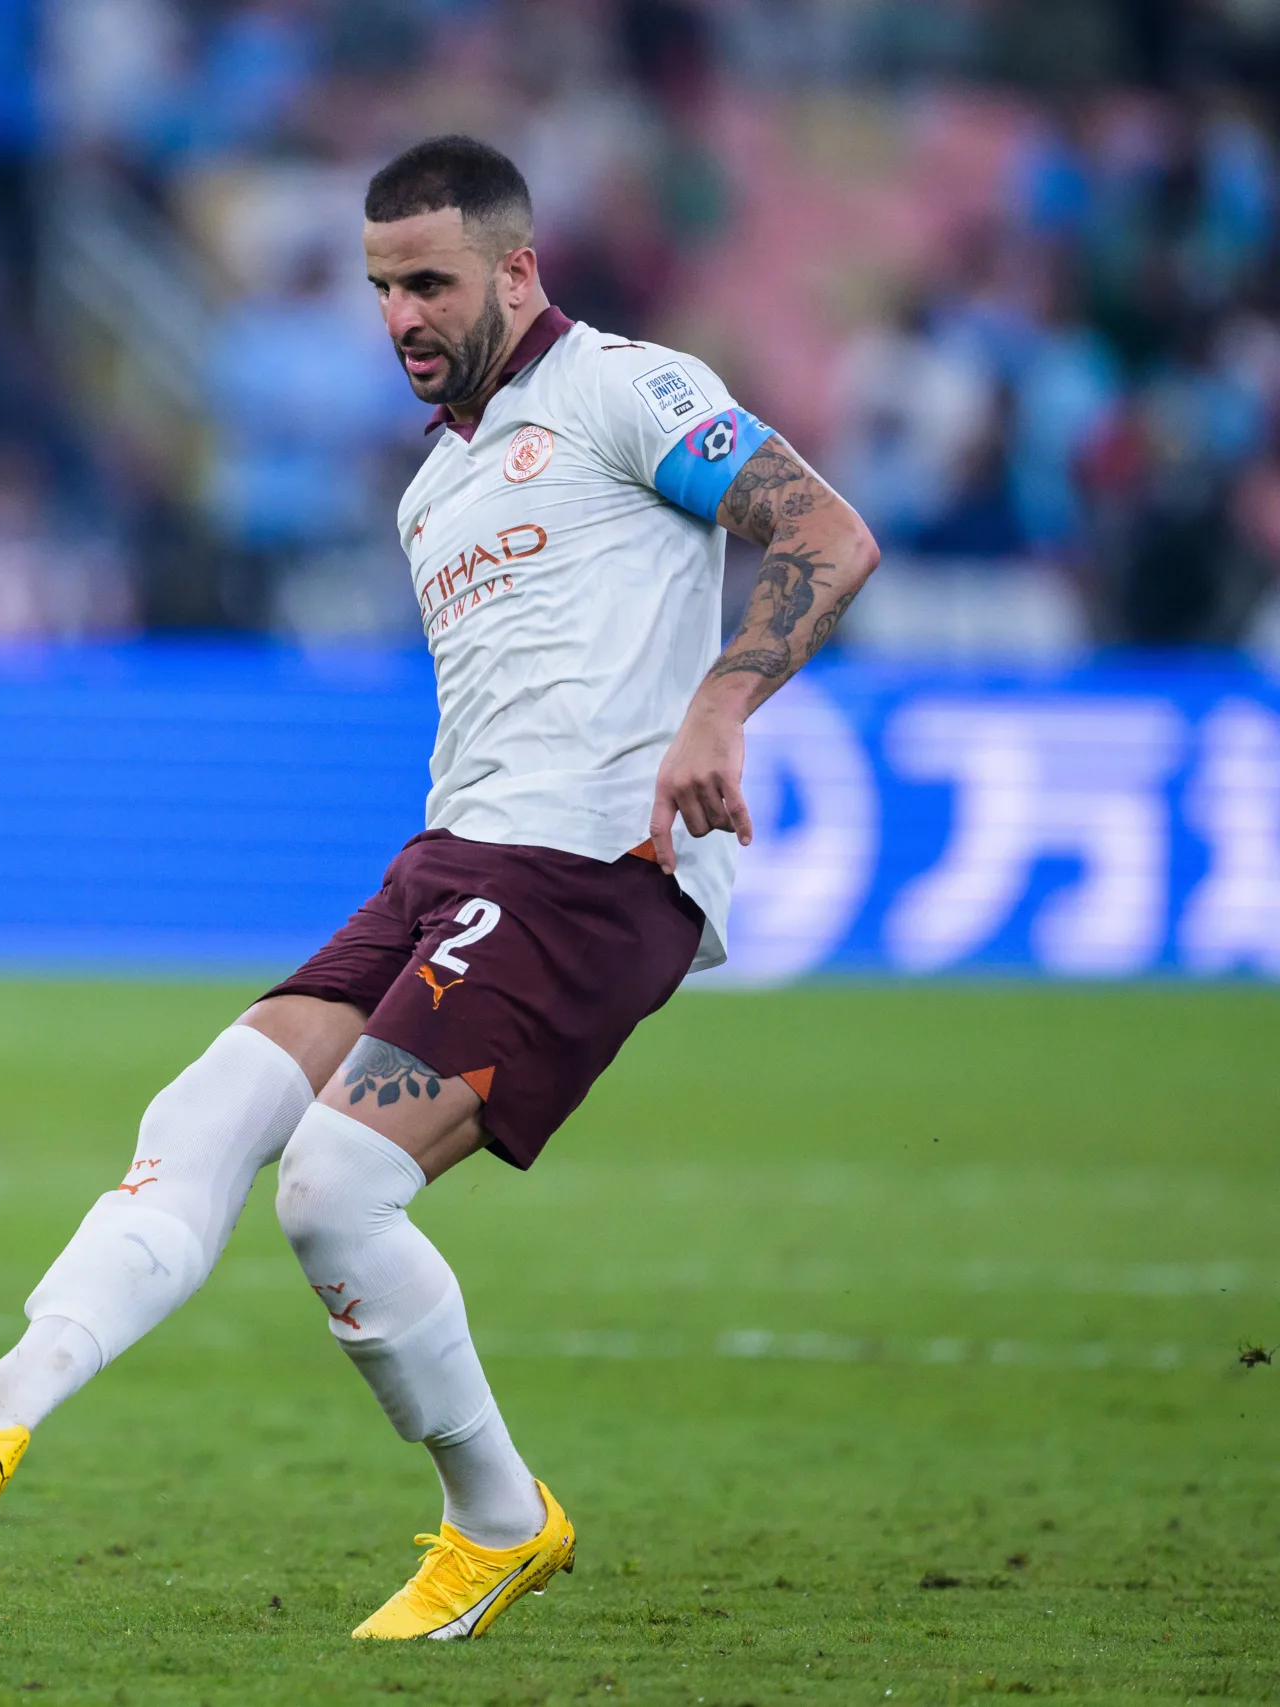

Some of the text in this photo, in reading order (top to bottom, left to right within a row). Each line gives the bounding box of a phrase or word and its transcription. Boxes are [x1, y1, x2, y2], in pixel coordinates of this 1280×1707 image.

[646, 371, 679, 389] FOOTBALL
[652, 378, 686, 400] UNITES
[658, 386, 694, 411] the World
[675, 402, 692, 415] FIFA
[429, 897, 502, 975] 2
